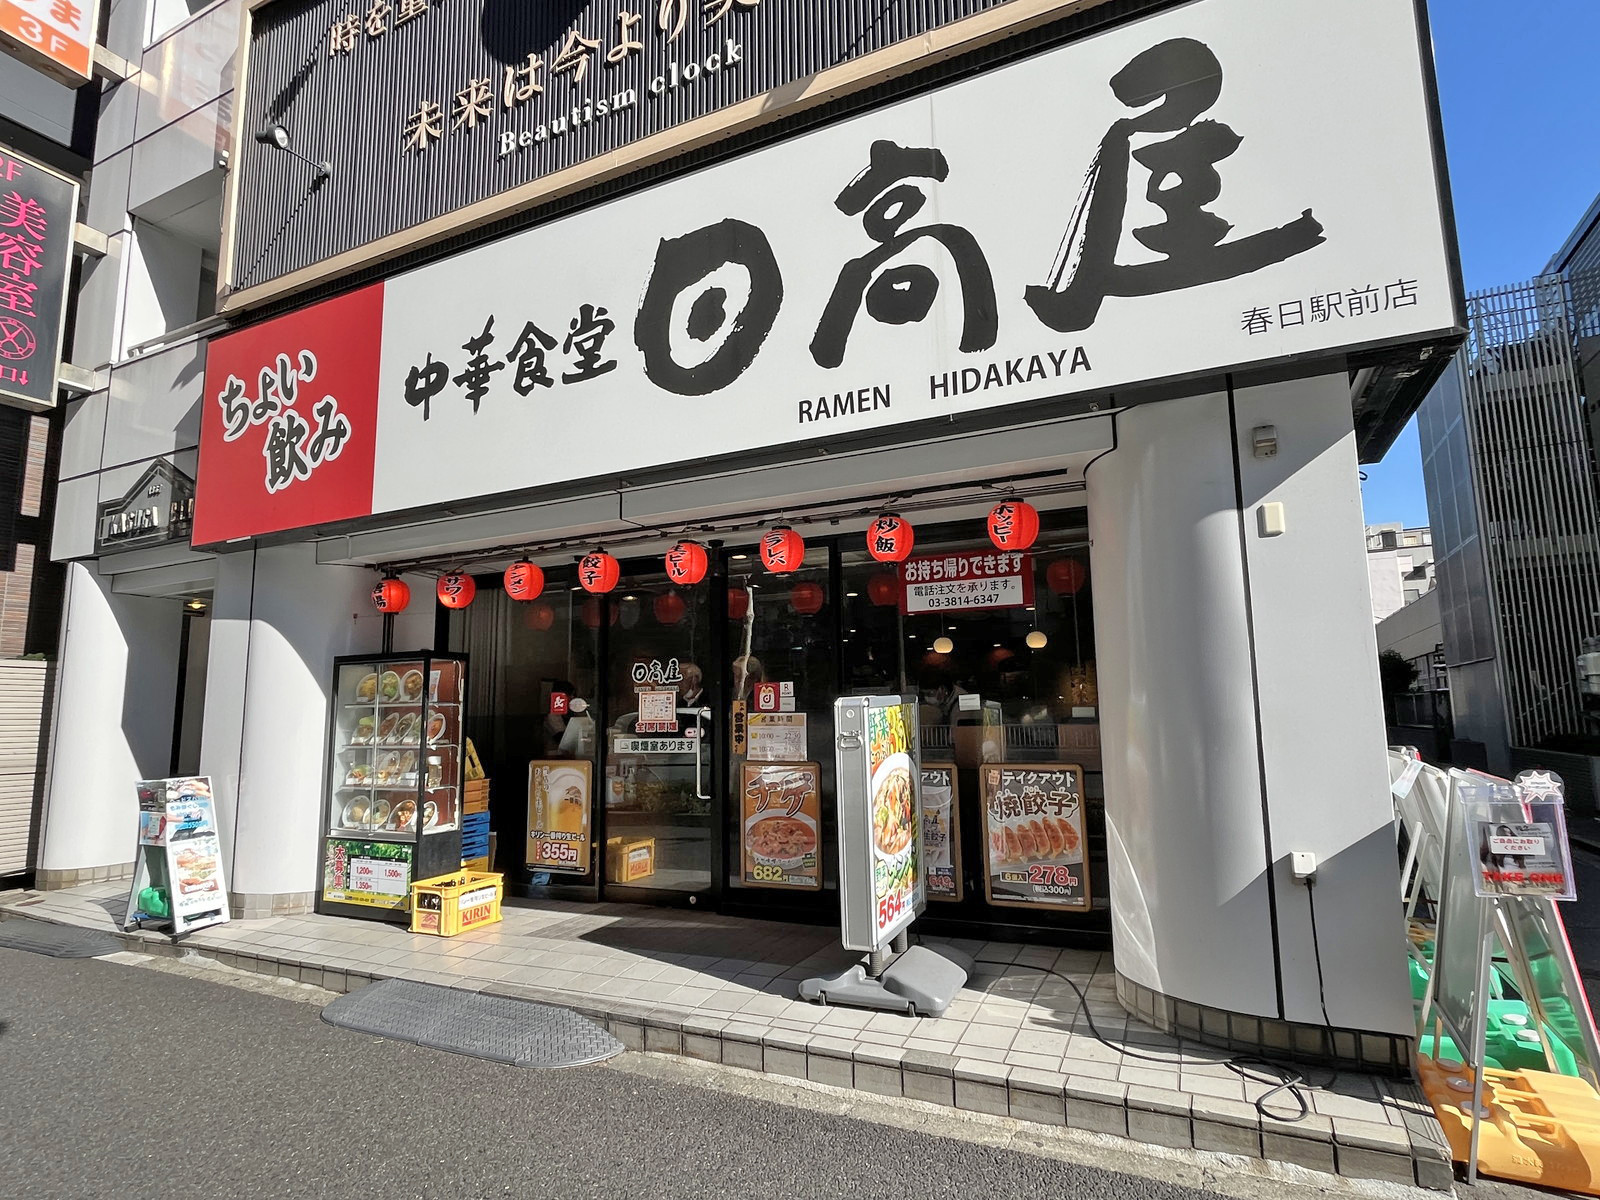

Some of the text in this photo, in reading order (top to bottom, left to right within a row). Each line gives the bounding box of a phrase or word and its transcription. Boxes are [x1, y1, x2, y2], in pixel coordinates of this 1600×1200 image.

[18, 16, 69, 53] 3F
[498, 38, 743, 157] Beautism clock
[634, 37, 1326, 397] 日高屋
[0, 190, 48, 318] 美容室
[1241, 278, 1420, 336] 春日駅前店
[405, 302, 618, 421] 中華食堂
[799, 346, 1093, 425] RAMEN HIDAKAYA
[264, 397, 352, 495] 飲み
[874, 517, 900, 553] 炒飯
[582, 556, 602, 585] 餃子
[668, 545, 690, 577] 生ビール
[905, 552, 1024, 581] お持ち帰りできます
[444, 575, 466, 605] サワー
[913, 579, 1017, 597] 電話注文を承ります。
[928, 594, 1000, 608] 03-3814-6347
[633, 658, 683, 683] 日高屋
[630, 740, 695, 752] 喫煙室あります
[1002, 771, 1076, 787] テイクアウト
[994, 788, 1074, 820] 焼餃子
[542, 841, 578, 861] 355円
[1028, 865, 1078, 887] 278円
[1482, 872, 1565, 884] TAKE ONE
[462, 904, 491, 922] KIRIN
